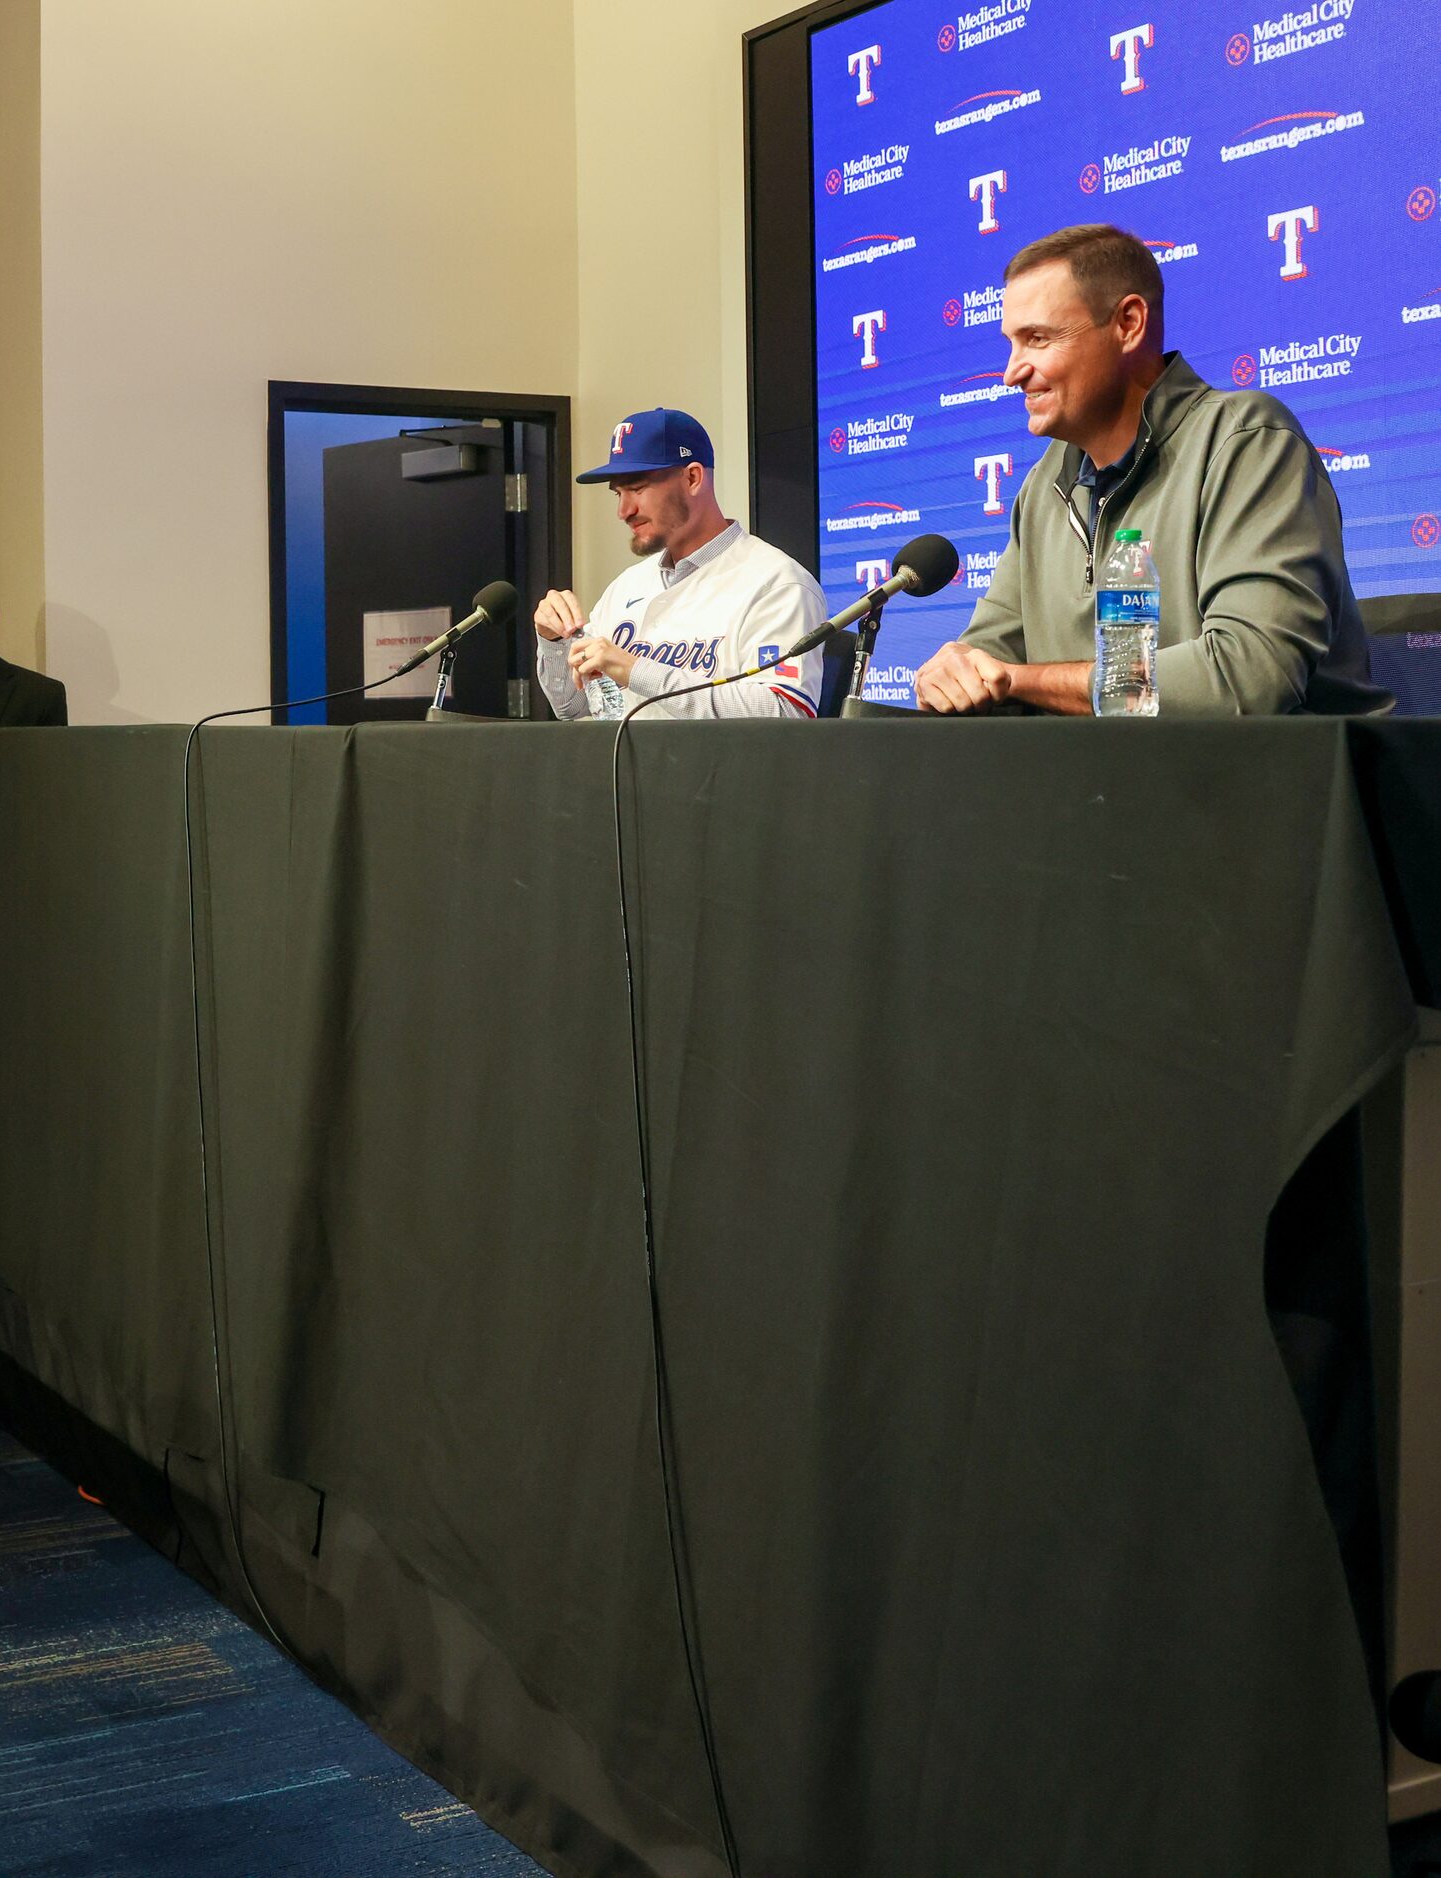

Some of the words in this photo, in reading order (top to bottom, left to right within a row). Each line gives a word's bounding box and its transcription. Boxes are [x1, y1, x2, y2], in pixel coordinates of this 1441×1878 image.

[958, 0, 1007, 33] Medical
[958, 14, 1026, 51] Healthcare
[1253, 3, 1318, 44] Medical
[1319, 0, 1355, 20] City
[1110, 23, 1155, 95] T
[1253, 22, 1345, 65] Healthcare
[848, 44, 882, 106] T
[935, 89, 1041, 135] texasrangers.com
[1220, 111, 1365, 163] texasrangers.com
[843, 149, 886, 178] Medical
[886, 144, 909, 163] City
[1103, 140, 1159, 174] Medical
[1160, 136, 1192, 157] City
[844, 165, 903, 195] Healthcare
[1104, 159, 1183, 194] Healthcare
[968, 169, 1007, 235] T
[822, 236, 916, 272] texasrangers.com
[1267, 205, 1319, 282] T
[963, 286, 1006, 309] Medica
[963, 303, 1003, 327] Health
[852, 309, 886, 369] T
[1259, 337, 1325, 367] Medical
[1325, 334, 1362, 357] City
[1260, 360, 1351, 388] Healthcare
[612, 422, 634, 454] T
[847, 415, 890, 438] Medical
[890, 413, 914, 432] City
[848, 434, 907, 455] Healthcare
[974, 453, 1013, 516] T
[826, 509, 920, 532] texasrangers.com
[862, 684, 910, 701] ealthcare
[865, 666, 893, 684] dical
[893, 666, 915, 687] City
